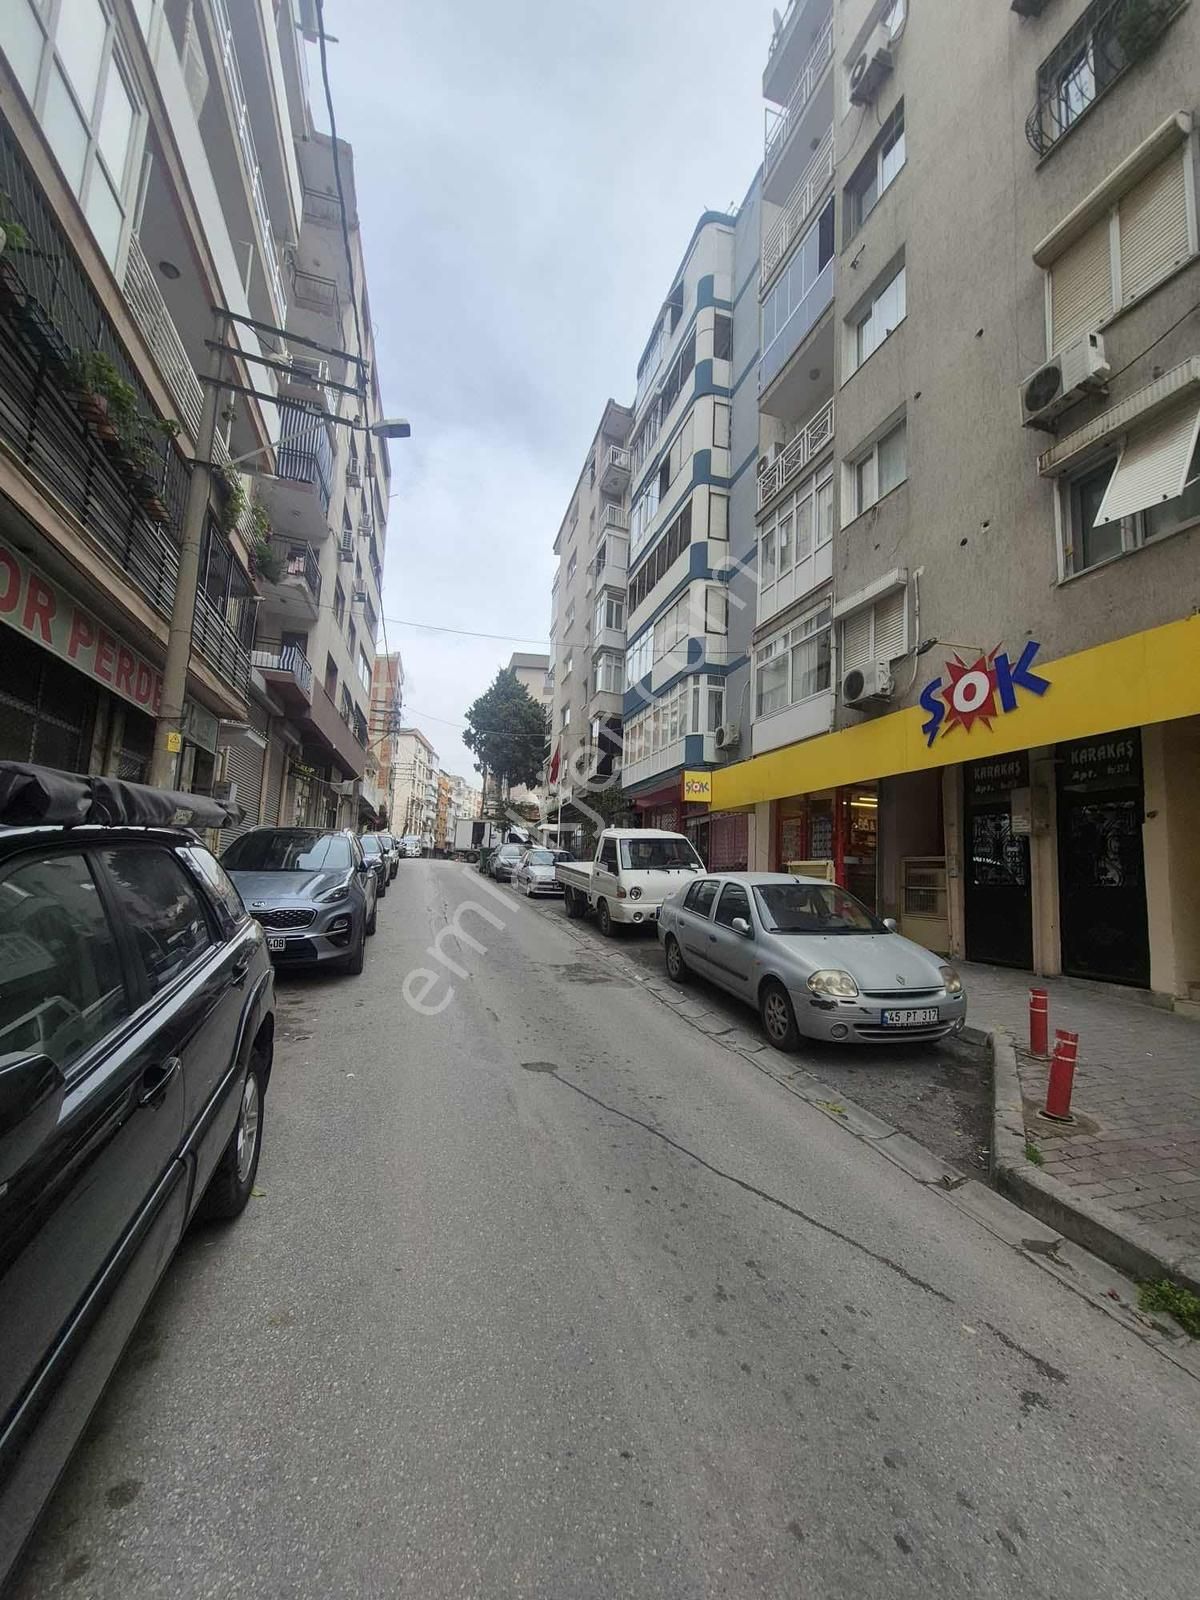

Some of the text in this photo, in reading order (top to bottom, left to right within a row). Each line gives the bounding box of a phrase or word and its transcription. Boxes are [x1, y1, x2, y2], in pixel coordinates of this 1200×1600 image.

[920, 641, 1051, 747] ŞOK
[889, 1010, 936, 1022] 45 PT 317
